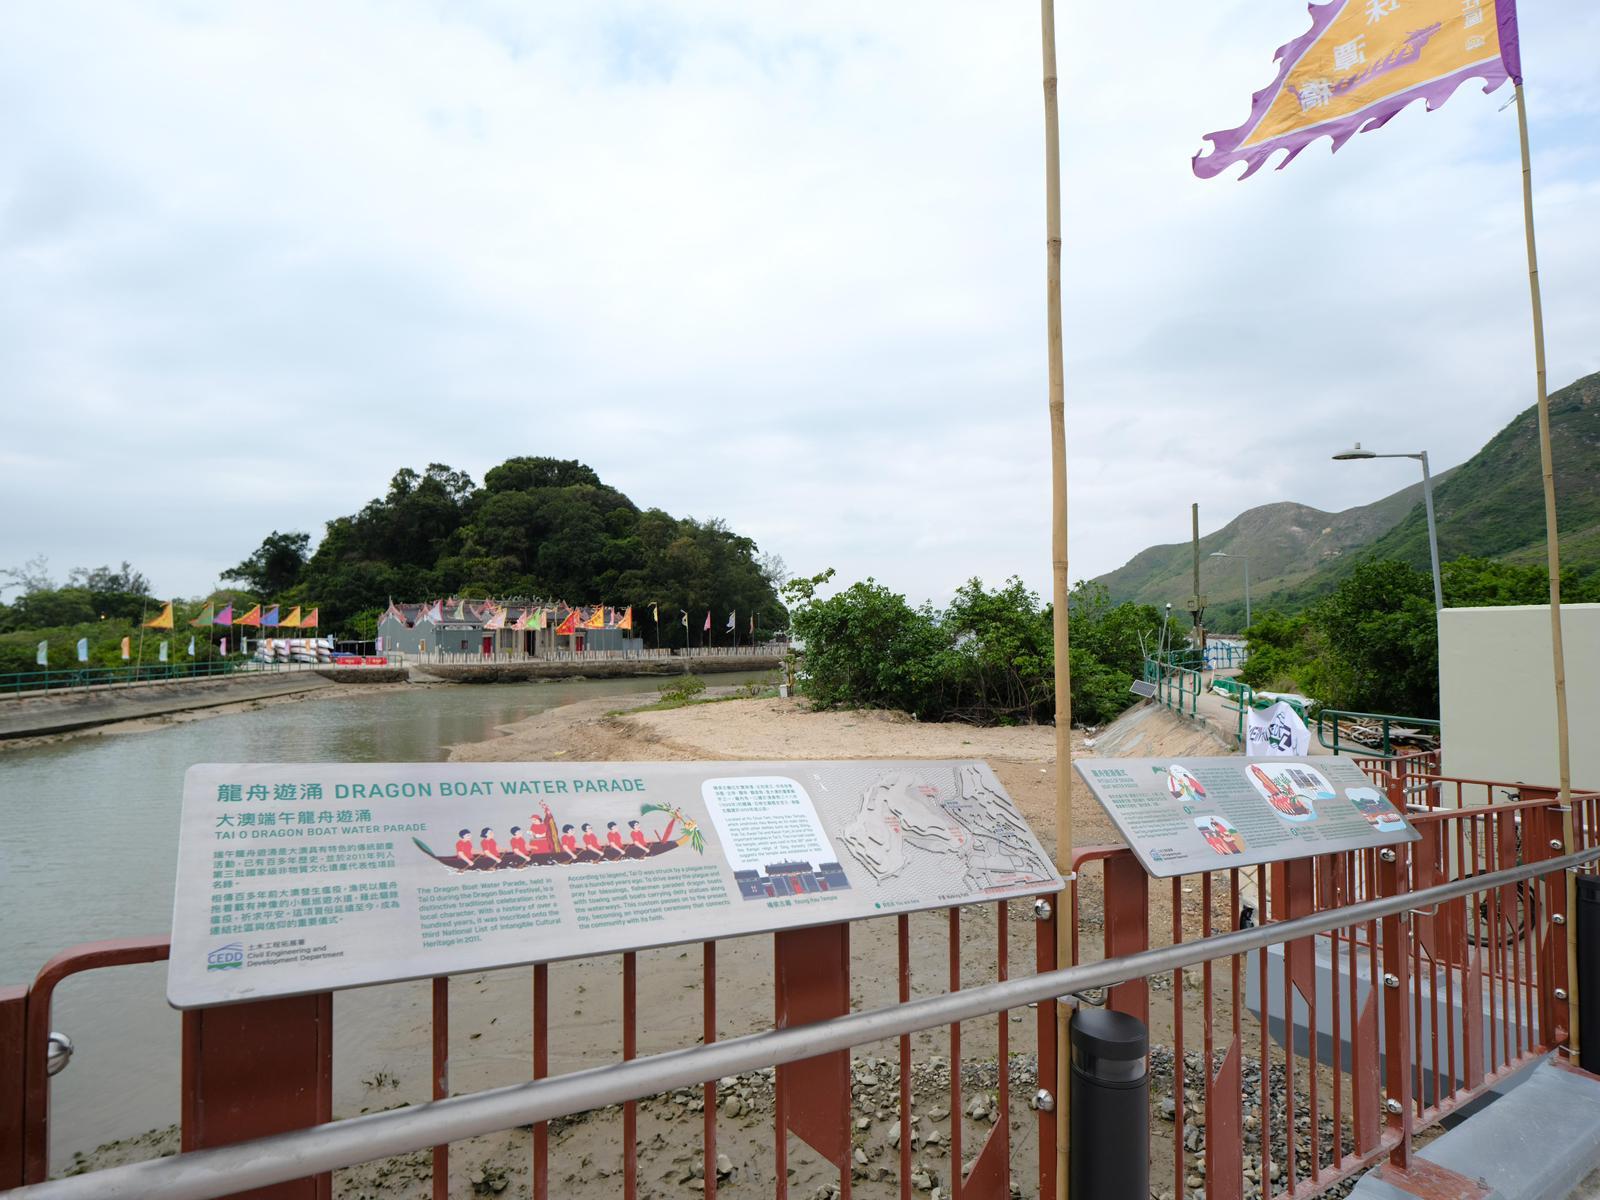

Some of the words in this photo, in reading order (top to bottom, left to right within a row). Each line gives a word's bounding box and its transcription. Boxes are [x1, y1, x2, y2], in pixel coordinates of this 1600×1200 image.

[217, 783, 323, 802] 龍舟遊涌
[335, 782, 432, 799] DRAGON
[440, 781, 494, 796] BOAT
[500, 779, 568, 795] WATER
[574, 778, 645, 792] PARADE
[216, 809, 372, 828] 大澳端午龍舟遊涌
[215, 830, 236, 840] TAI
[240, 830, 248, 840] O
[252, 828, 304, 839] DRAGON
[308, 827, 338, 836] BOAT
[342, 825, 380, 835] WATER
[384, 824, 428, 832] PARADE
[208, 952, 242, 964] CEDD
[247, 956, 298, 968] Development
[300, 952, 344, 961] Department
[266, 947, 311, 957] Engineering
